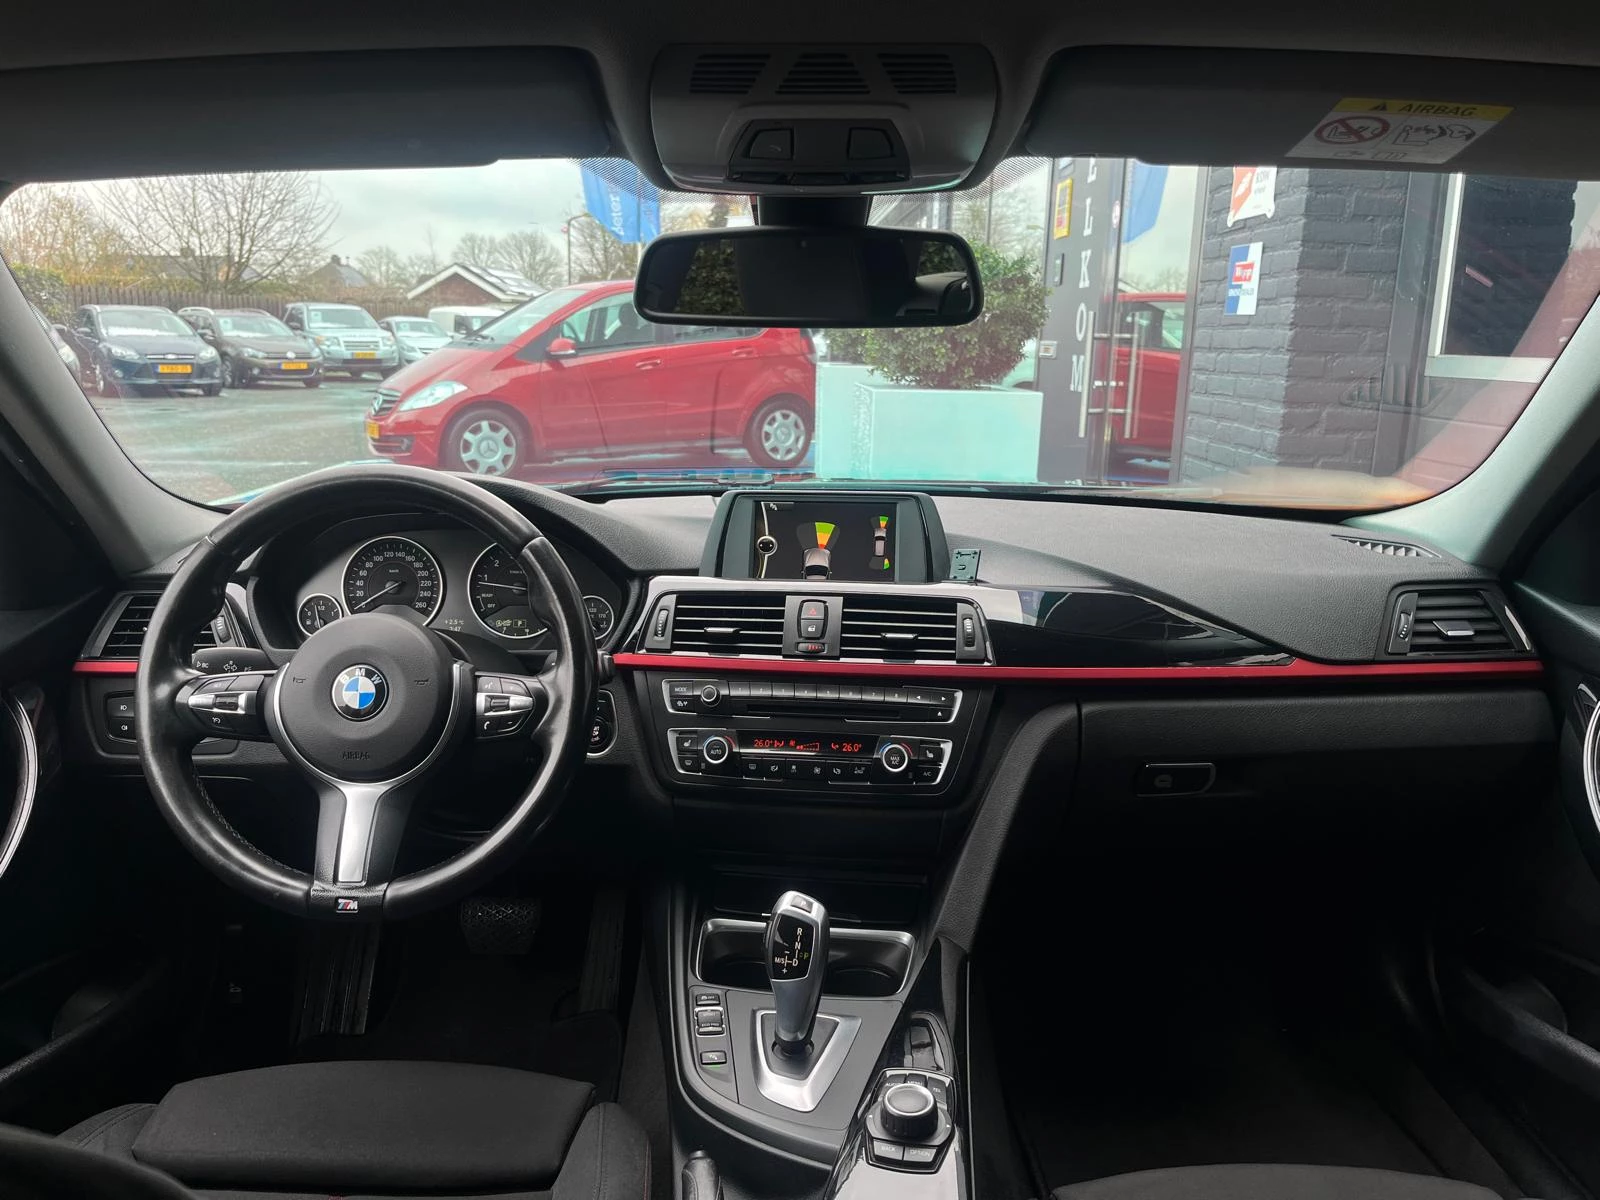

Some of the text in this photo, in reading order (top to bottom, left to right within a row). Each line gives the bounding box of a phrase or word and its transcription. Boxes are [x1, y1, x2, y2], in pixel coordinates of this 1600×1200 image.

[1399, 103, 1478, 117] AIRBAG
[340, 668, 381, 684] BMW
[342, 751, 370, 760] AIRBAG
[797, 927, 803, 935] R
[794, 942, 801, 950] N
[792, 958, 799, 967] D
